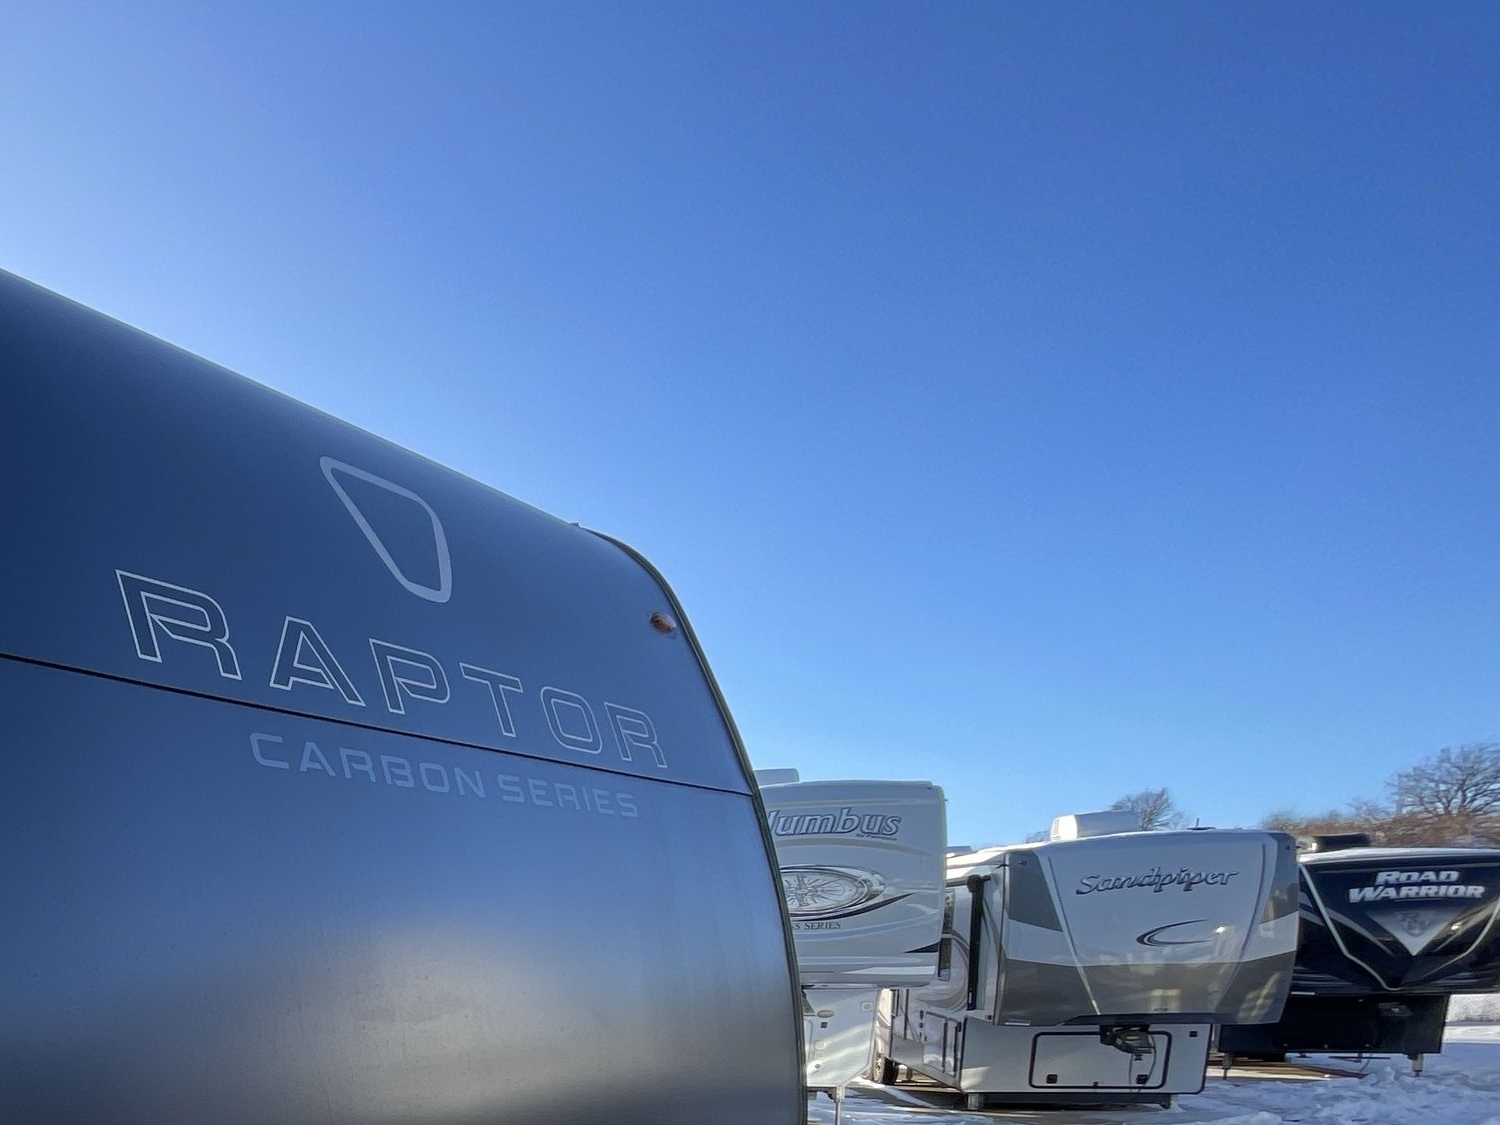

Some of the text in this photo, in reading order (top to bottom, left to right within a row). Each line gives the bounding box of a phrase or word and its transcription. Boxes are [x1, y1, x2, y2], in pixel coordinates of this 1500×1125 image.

[115, 569, 668, 769] RAPTOR
[249, 731, 638, 819] CARBON SERIES
[767, 807, 901, 836] lumbus
[1076, 866, 1241, 895] Sandpiper
[1374, 870, 1460, 885] ROAD
[1349, 885, 1485, 903] WARRIOR
[804, 921, 841, 930] SERIES
